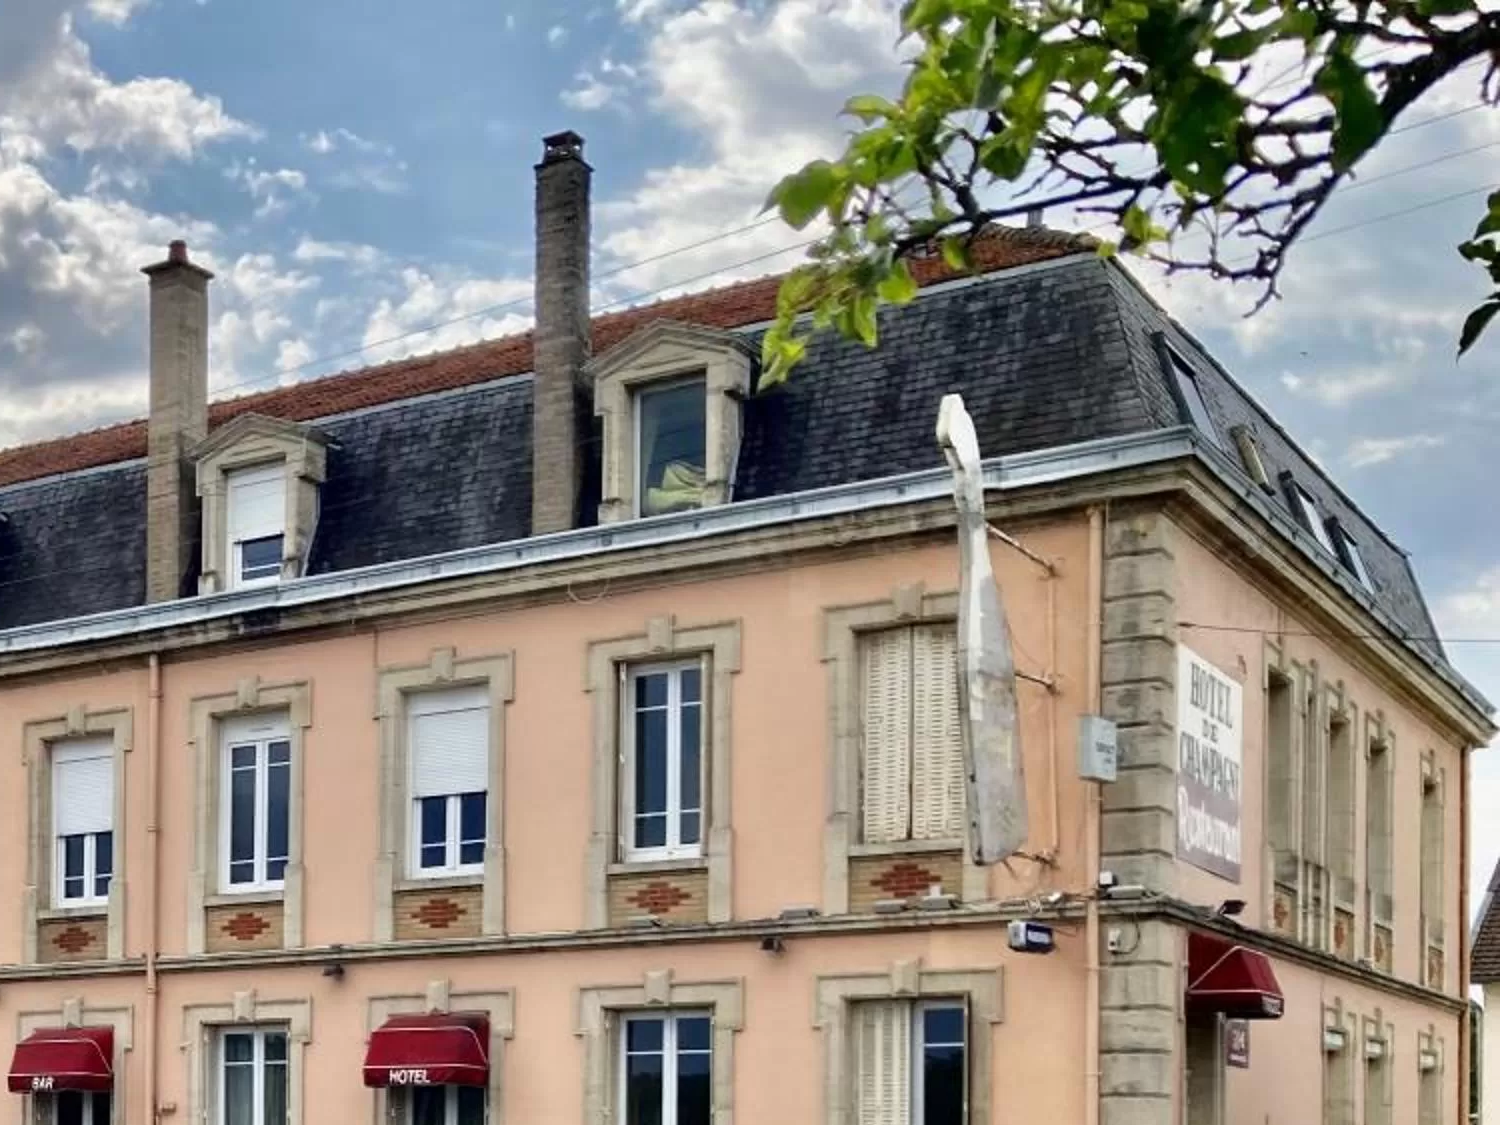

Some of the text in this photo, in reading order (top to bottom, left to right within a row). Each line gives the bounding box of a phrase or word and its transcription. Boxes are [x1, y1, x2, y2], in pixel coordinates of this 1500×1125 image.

[1190, 662, 1232, 729] HOTEL
[32, 1076, 53, 1090] BAR
[389, 1069, 431, 1085] HOTEL
